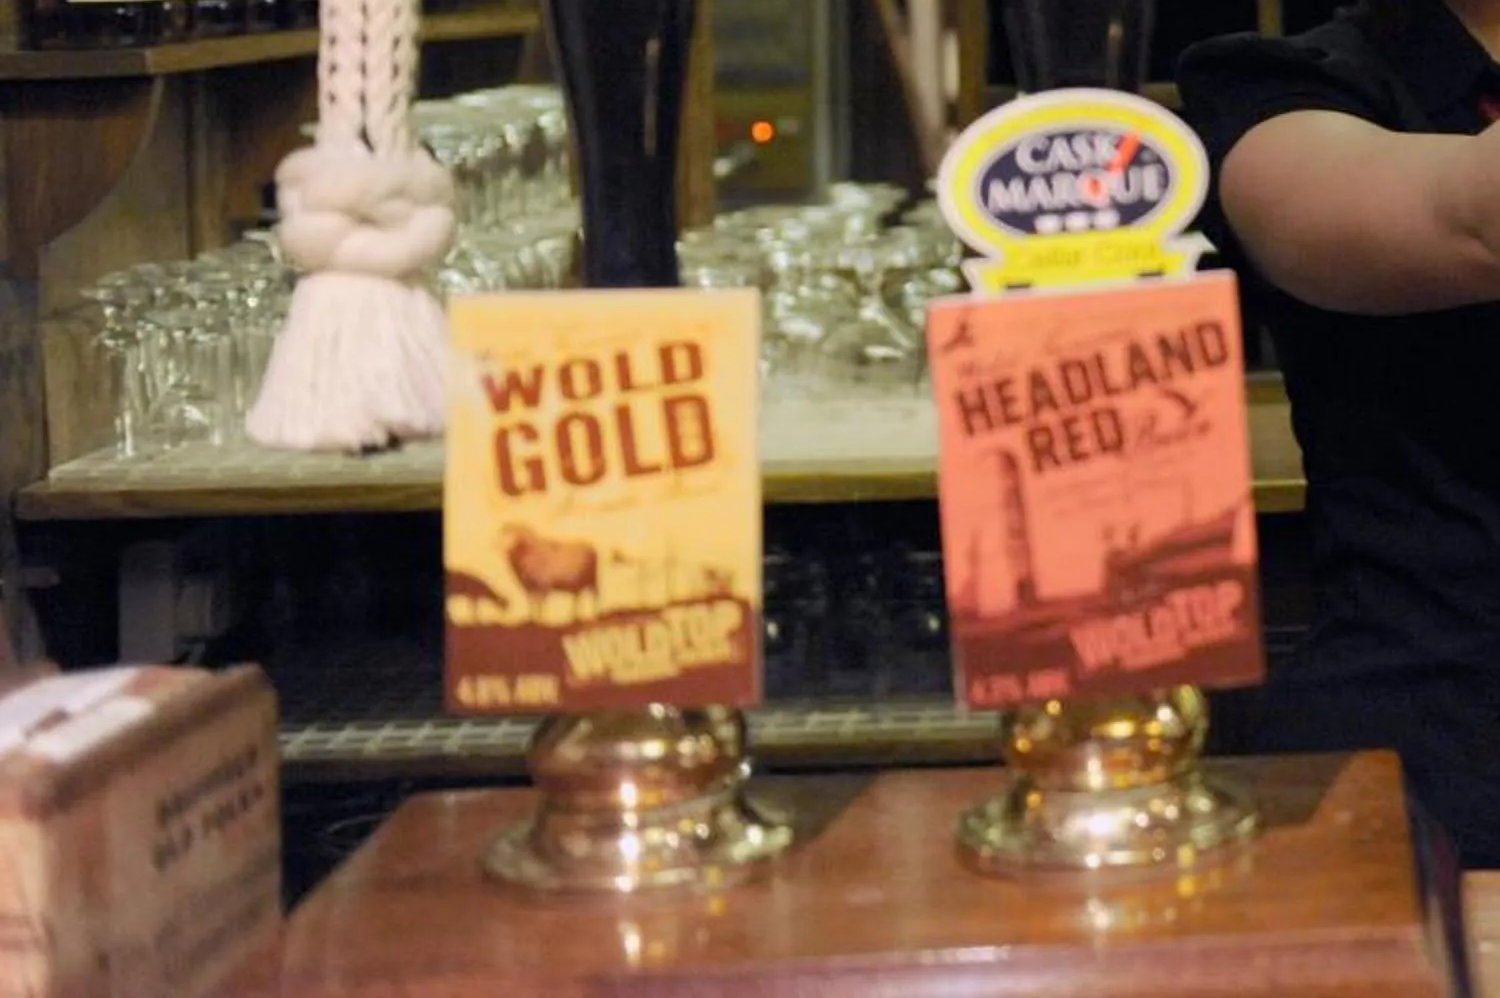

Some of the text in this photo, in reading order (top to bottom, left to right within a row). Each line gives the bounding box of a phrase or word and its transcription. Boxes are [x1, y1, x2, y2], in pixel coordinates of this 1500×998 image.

[1016, 132, 1126, 176] CASK
[483, 341, 705, 414] WOLD
[958, 321, 1229, 437] HEADLAND
[495, 393, 715, 497] GOLD
[1028, 408, 1124, 473] RED
